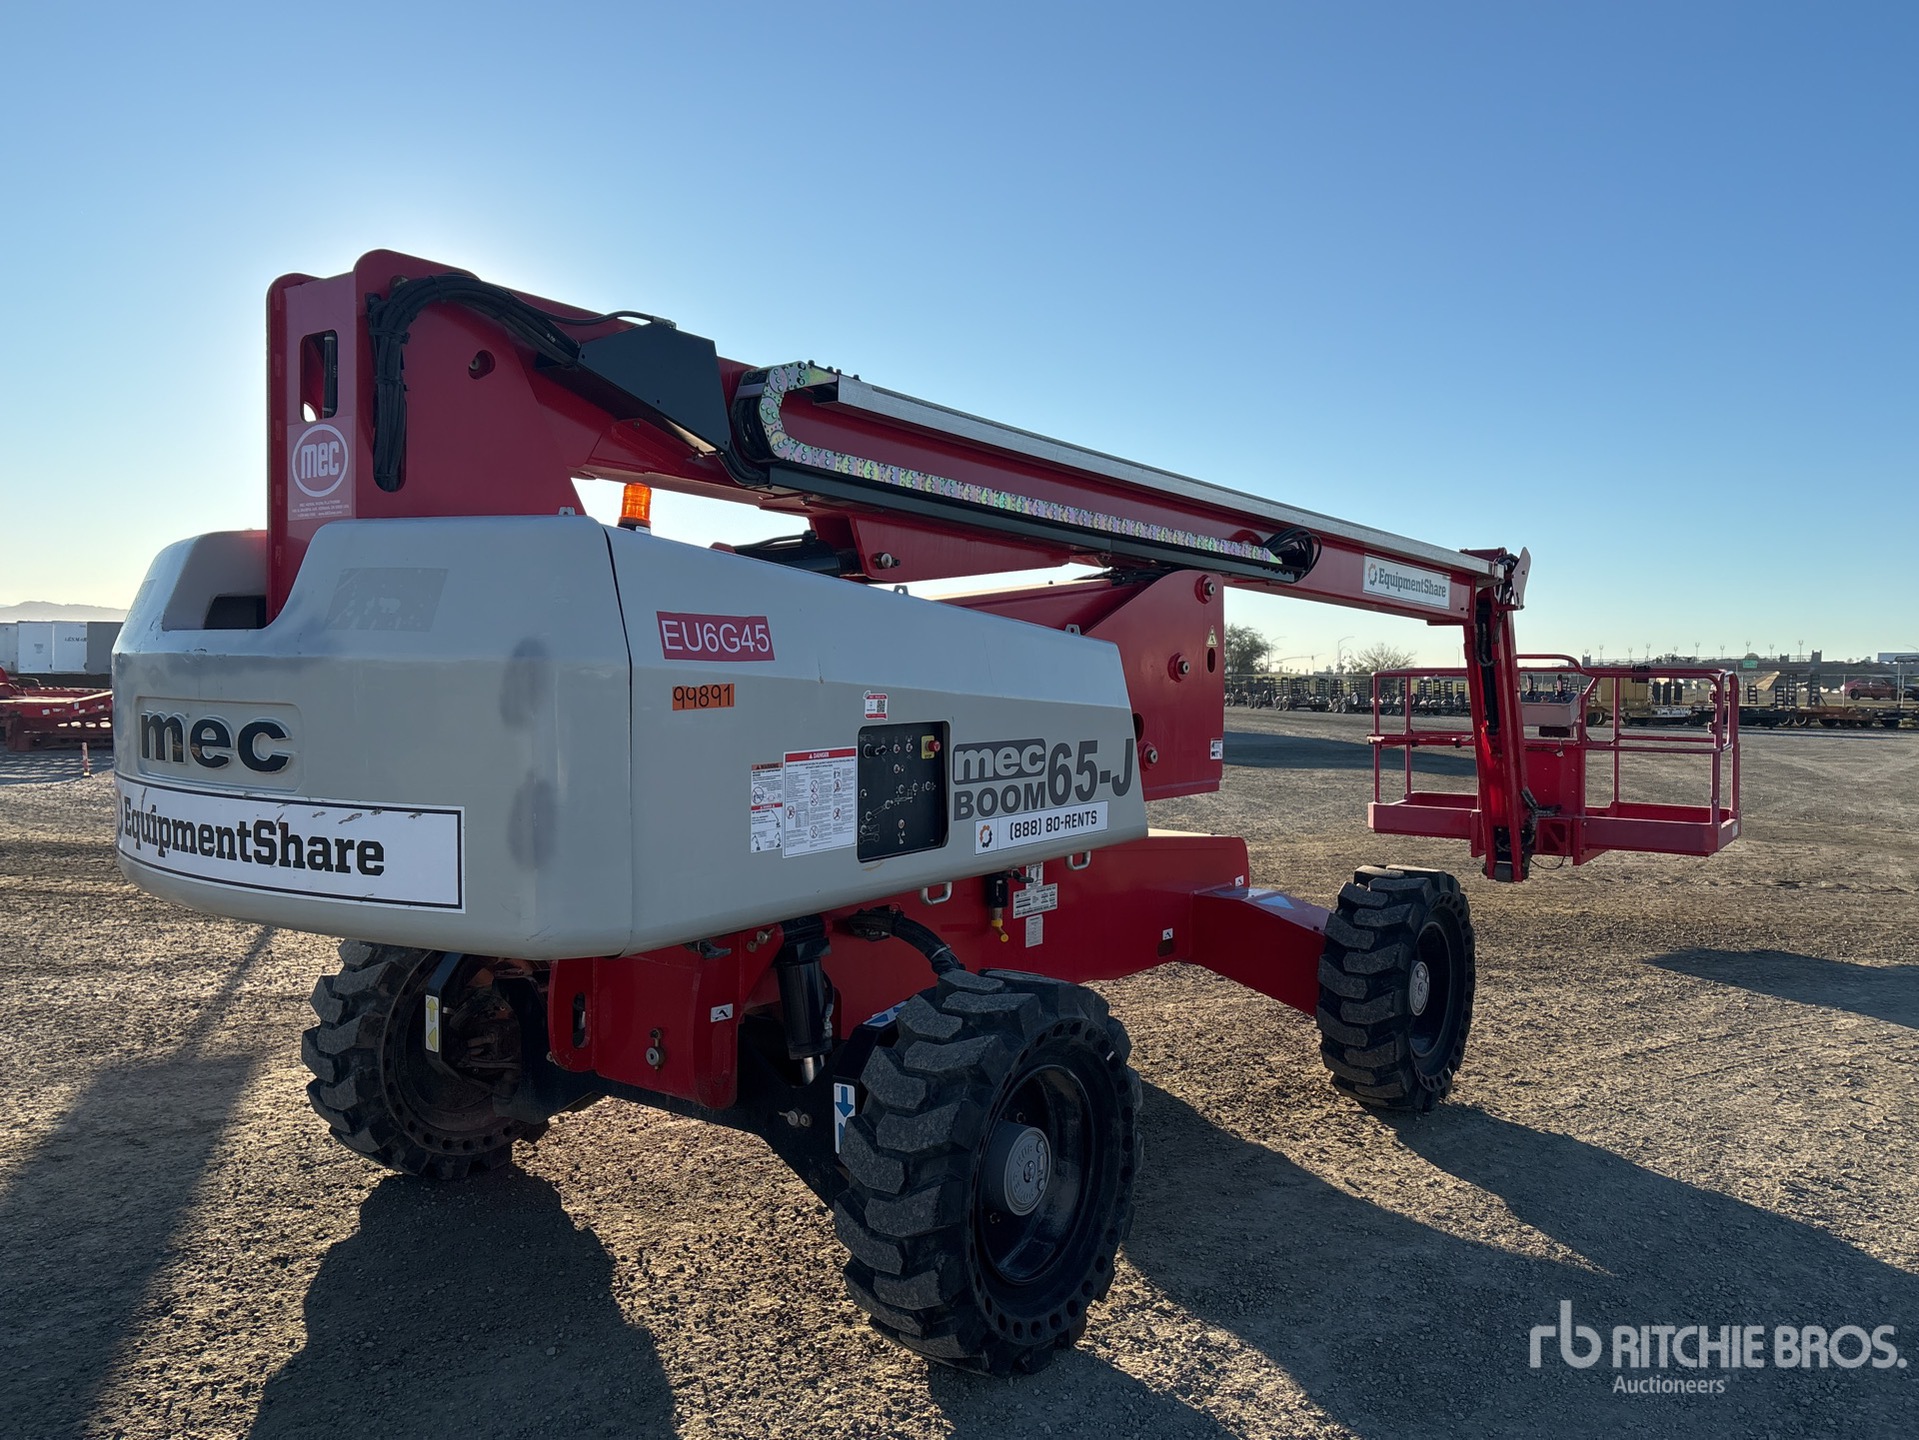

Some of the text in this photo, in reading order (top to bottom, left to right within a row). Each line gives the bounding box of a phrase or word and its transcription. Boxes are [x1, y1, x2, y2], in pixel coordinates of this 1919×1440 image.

[301, 441, 340, 480] mec
[1378, 568, 1447, 598] EquipmentShare
[661, 620, 770, 653] EU6G45
[673, 684, 732, 709] 99891
[140, 709, 292, 774] mec
[954, 744, 1046, 782] mec
[1047, 738, 1135, 806] 65-J
[954, 781, 1046, 821] BOOM
[124, 796, 385, 877] EquipmentShare
[1009, 810, 1098, 841] (888) 80-RENTS
